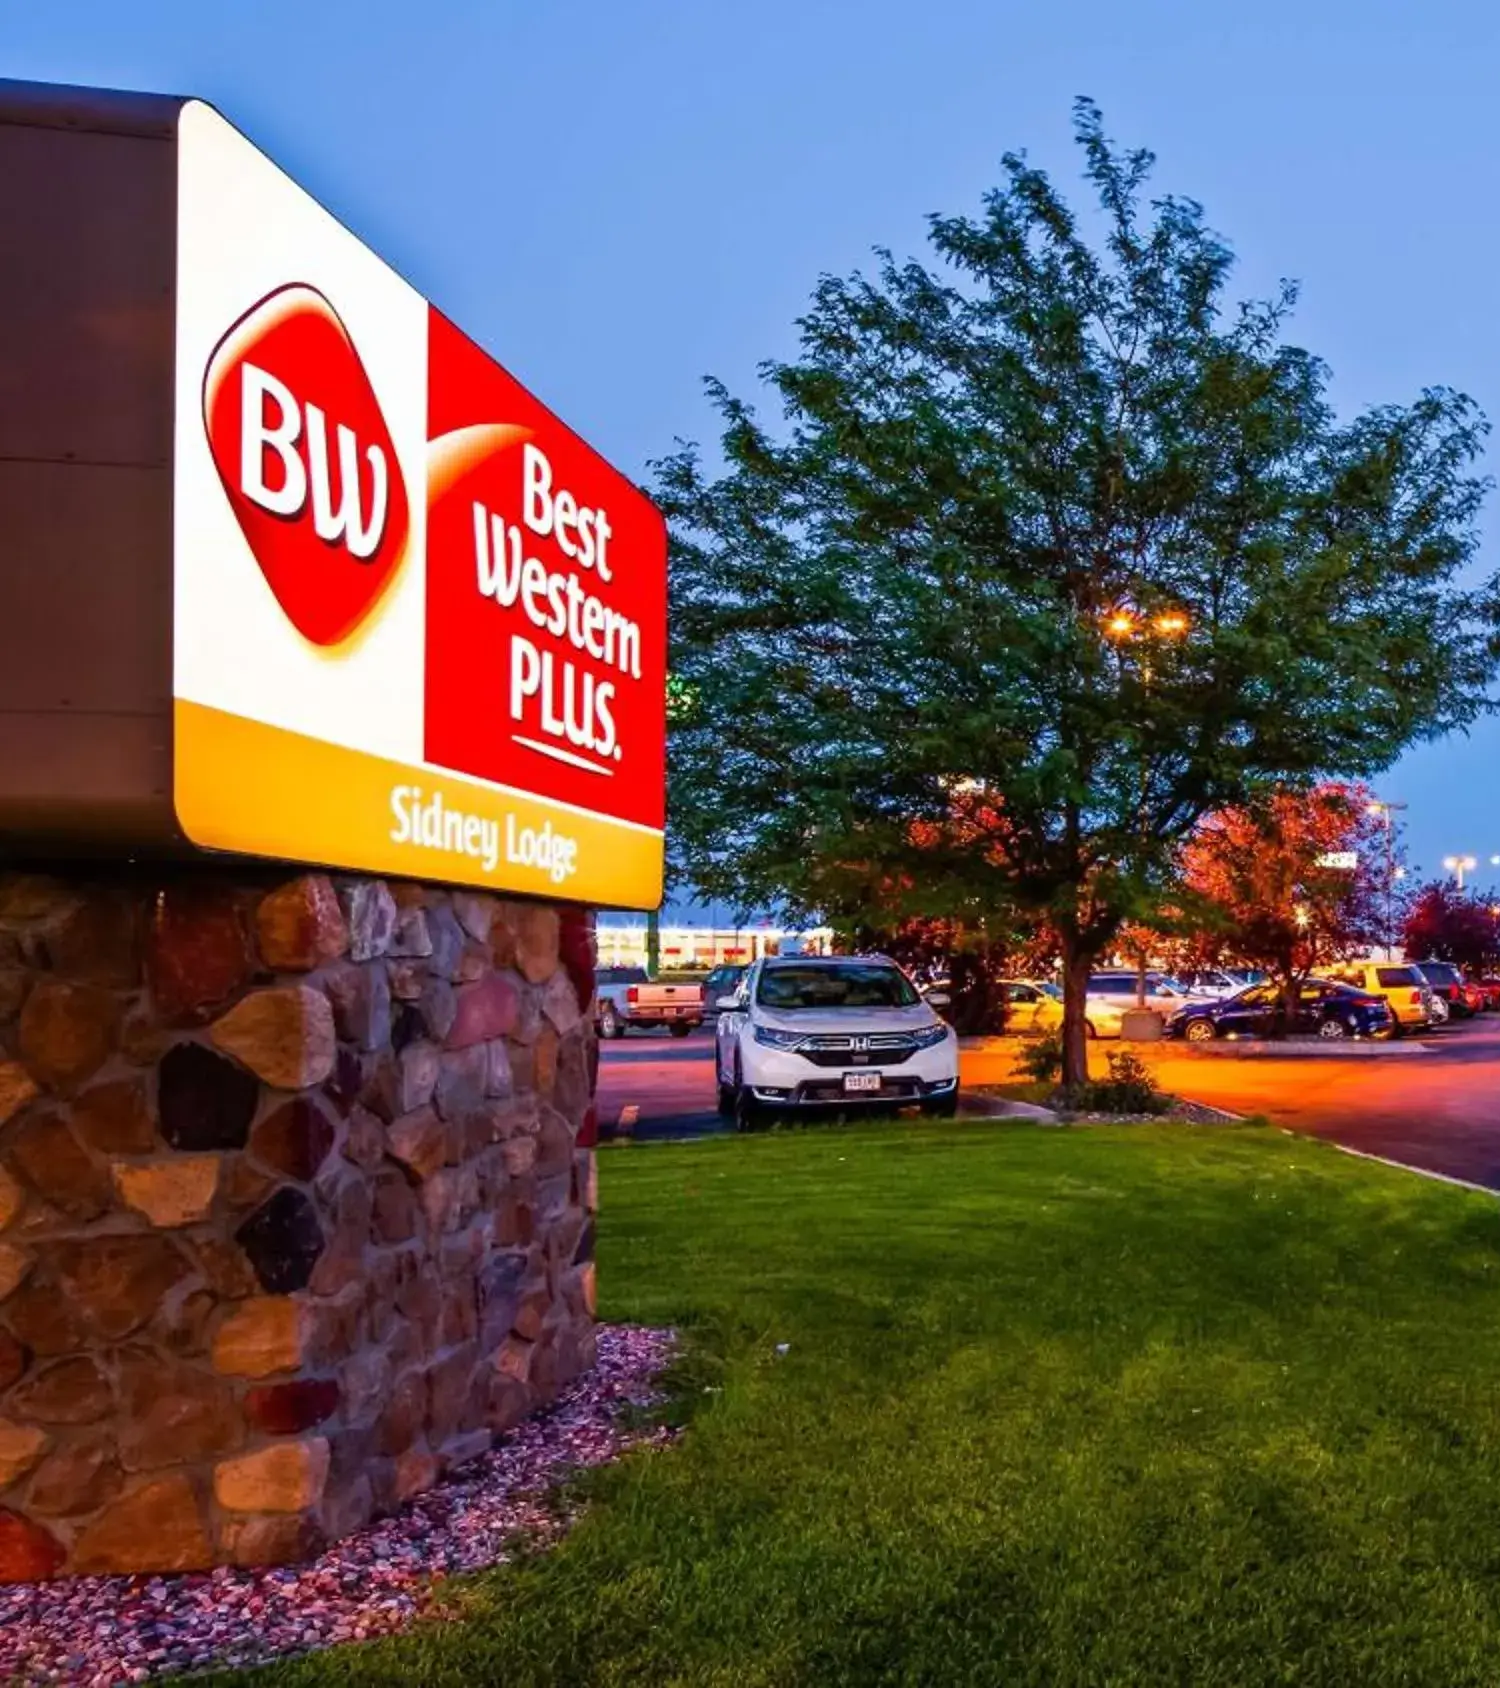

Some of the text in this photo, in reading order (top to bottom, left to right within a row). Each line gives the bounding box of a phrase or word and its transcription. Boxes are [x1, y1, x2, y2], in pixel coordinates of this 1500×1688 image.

[242, 362, 387, 557] BW
[523, 443, 612, 582] Best
[473, 502, 641, 679] Western
[390, 785, 578, 883] Sidney Lodge
